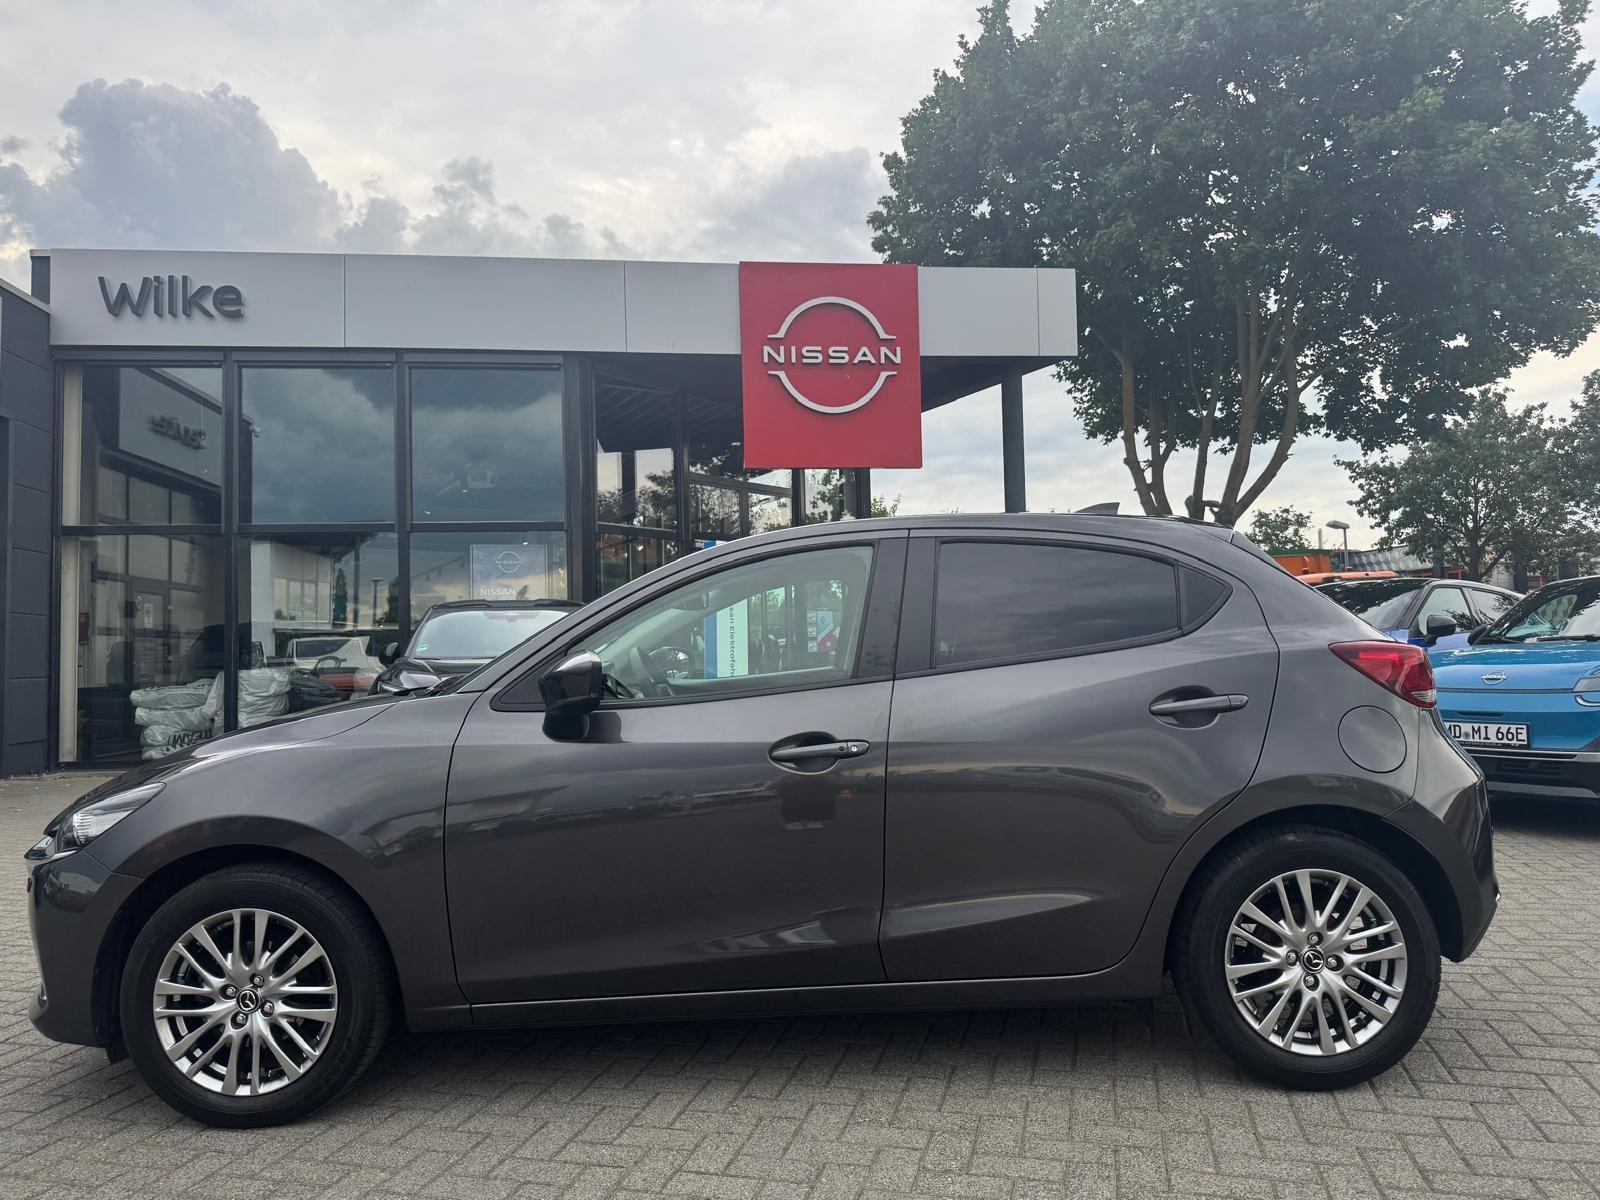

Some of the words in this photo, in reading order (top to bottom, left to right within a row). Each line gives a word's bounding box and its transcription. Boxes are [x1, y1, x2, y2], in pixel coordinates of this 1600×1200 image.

[98, 275, 245, 318] Wilke
[763, 345, 901, 364] NISSAN
[1471, 725, 1490, 740] MI
[1496, 726, 1526, 742] 66E
